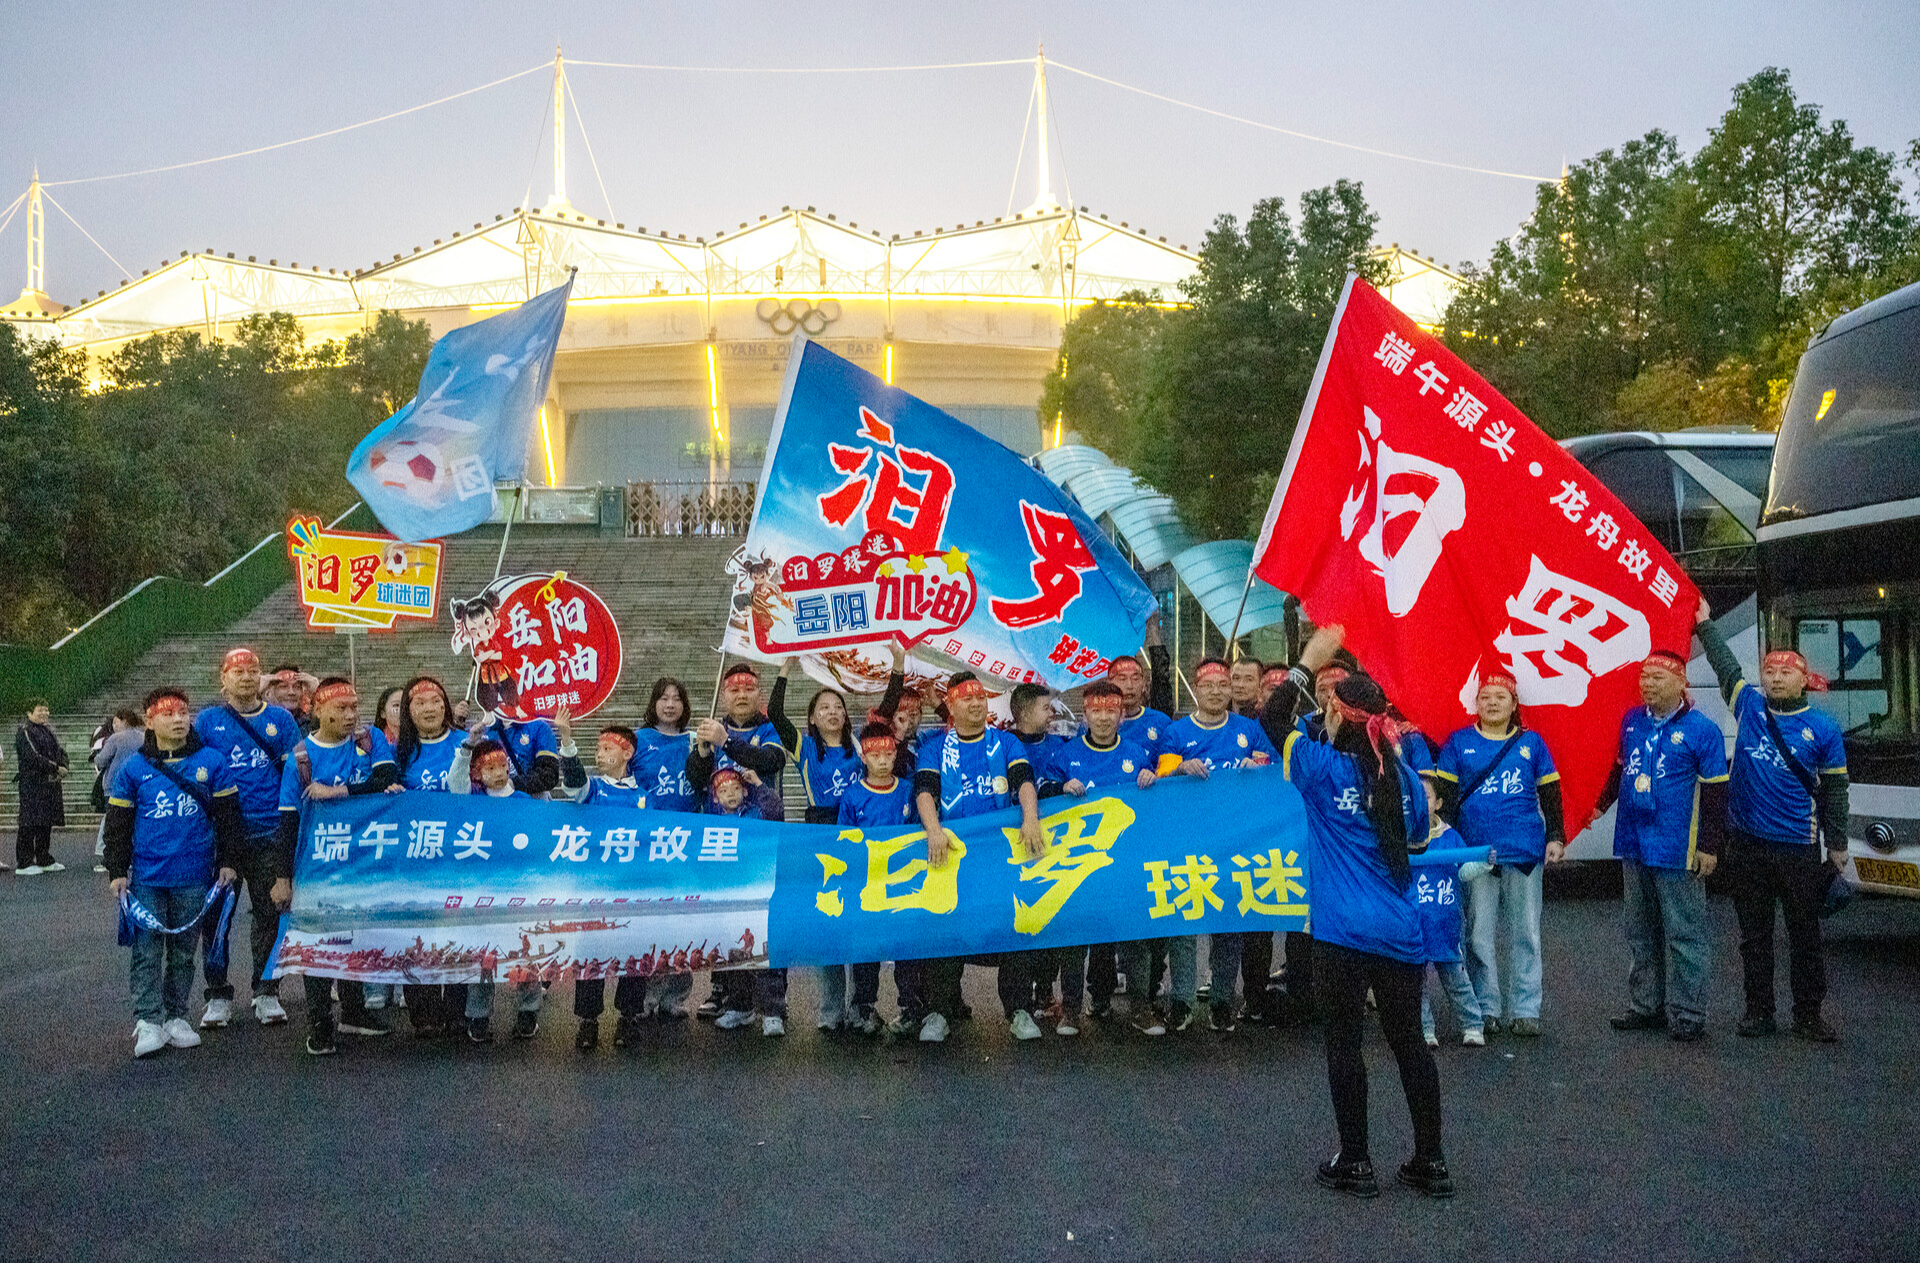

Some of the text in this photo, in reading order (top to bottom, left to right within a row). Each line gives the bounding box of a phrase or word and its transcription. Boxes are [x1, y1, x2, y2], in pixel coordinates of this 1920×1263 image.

[816, 406, 1099, 632] 汨罗
[305, 553, 382, 606] 汨罗
[786, 533, 890, 581] 汨罗球迷
[1339, 404, 1653, 716] 汨罗
[376, 582, 431, 608] 球迷团
[793, 574, 969, 636] 岳阳 加油
[503, 596, 590, 649] 岳阳
[516, 642, 599, 697] 加油
[533, 691, 581, 711] 汨罗球迷
[312, 820, 740, 863] 端午源头·龙舟故里
[814, 796, 1311, 936] 汨罗 球迷
